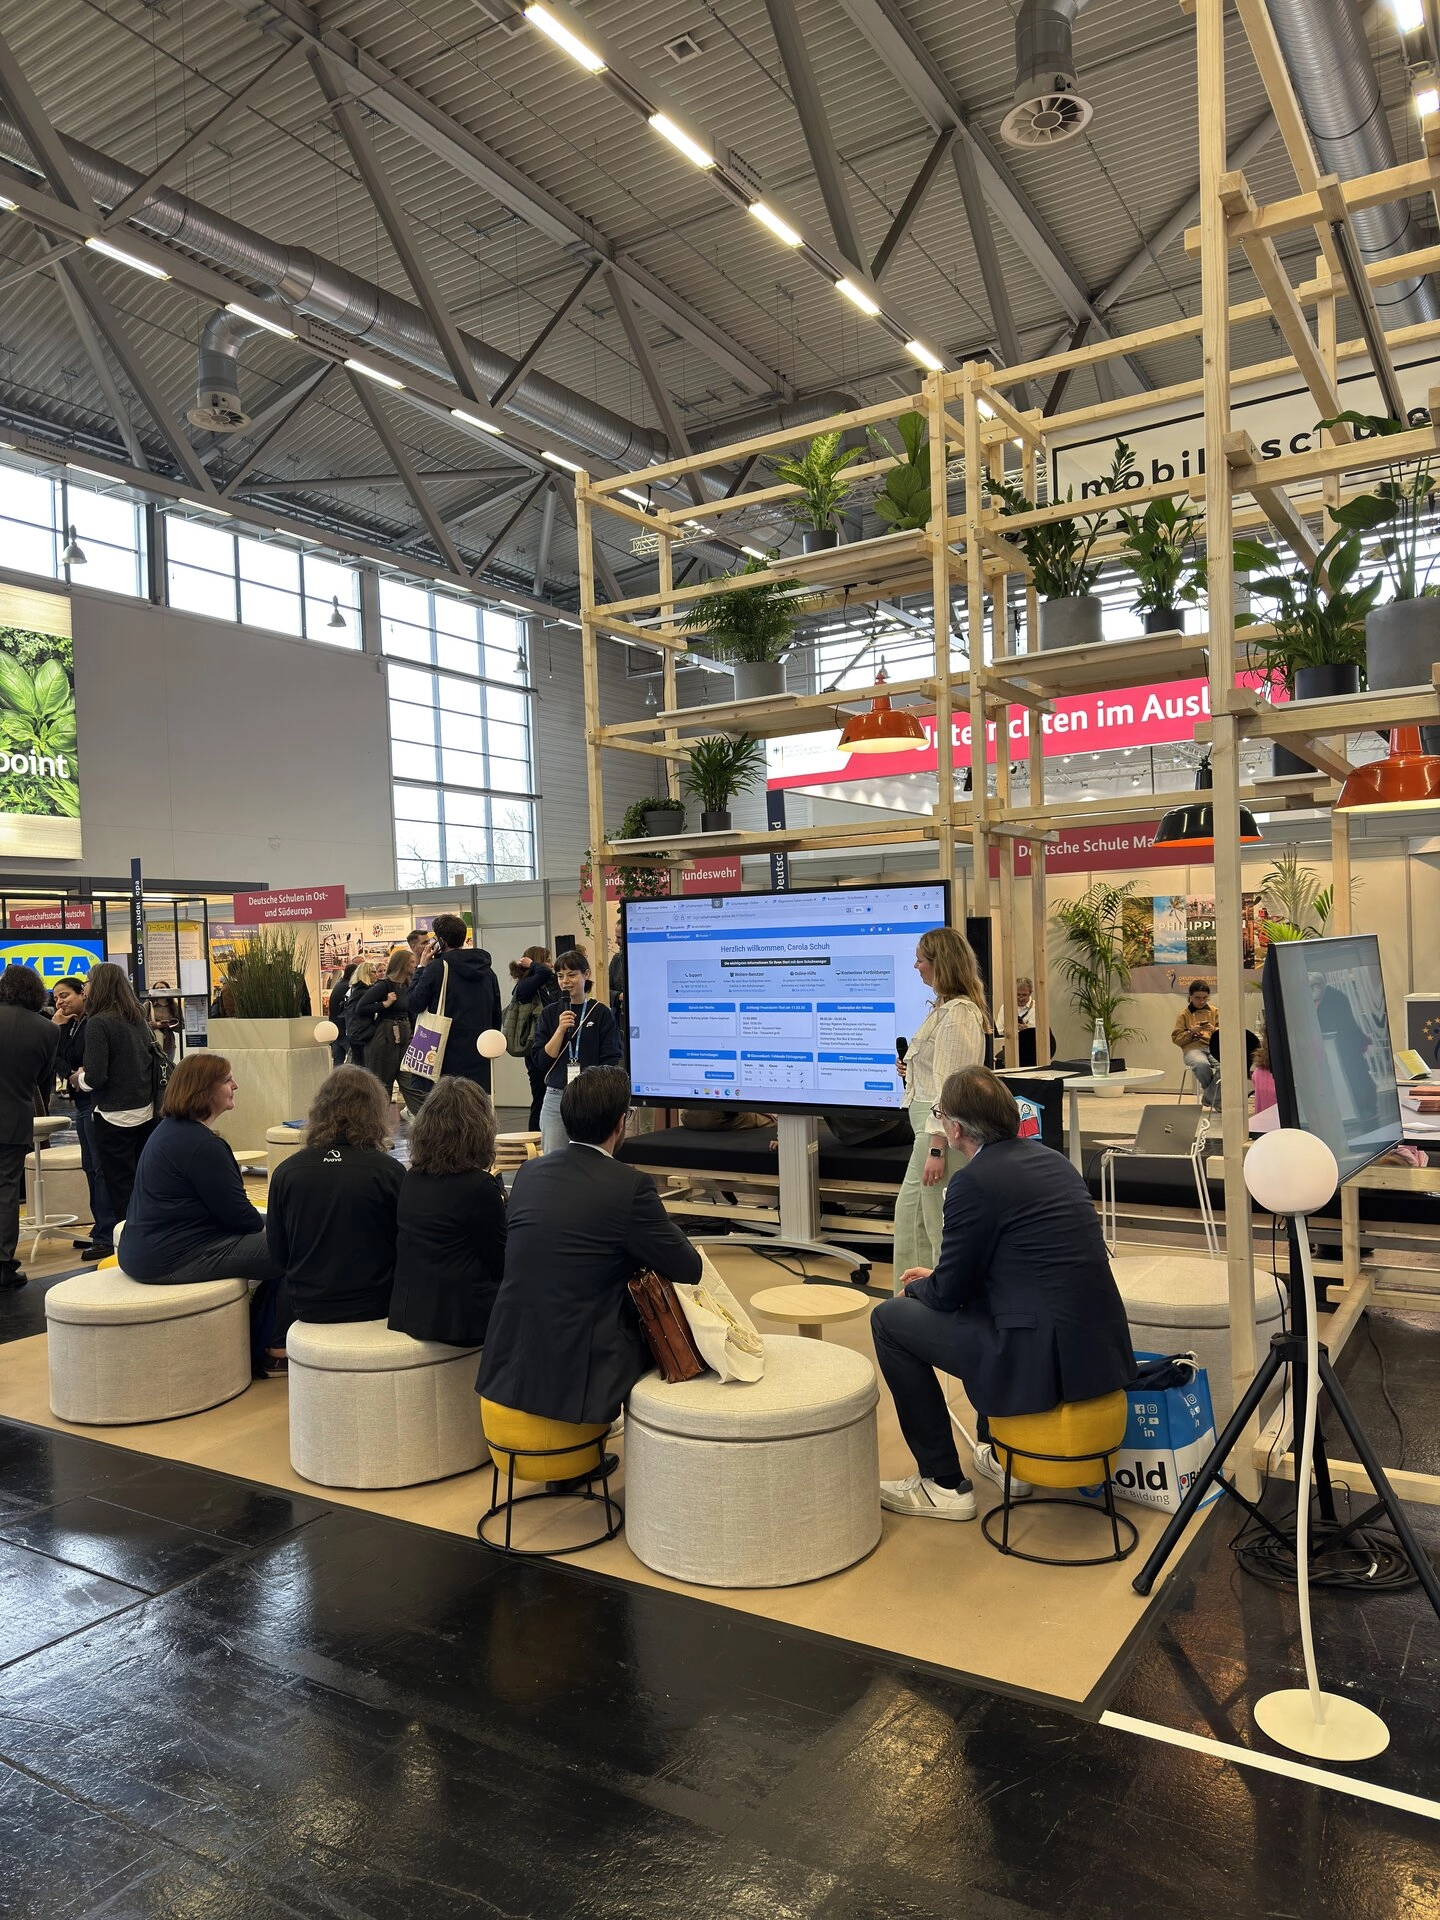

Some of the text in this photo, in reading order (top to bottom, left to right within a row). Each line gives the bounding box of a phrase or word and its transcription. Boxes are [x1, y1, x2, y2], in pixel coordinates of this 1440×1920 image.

[1082, 448, 1204, 500] mobil
[1097, 700, 1133, 728] im
[1019, 836, 1154, 857] Dtsche Schule Ma
[249, 896, 277, 905] Deutsche
[279, 894, 304, 904] Schulen
[313, 892, 328, 900] Ost-
[15, 912, 62, 921] Gemeinschaftsstand
[265, 906, 312, 917] und Südeuropa
[1111, 1461, 1168, 1490] old
[1130, 1490, 1170, 1505] Bildung
